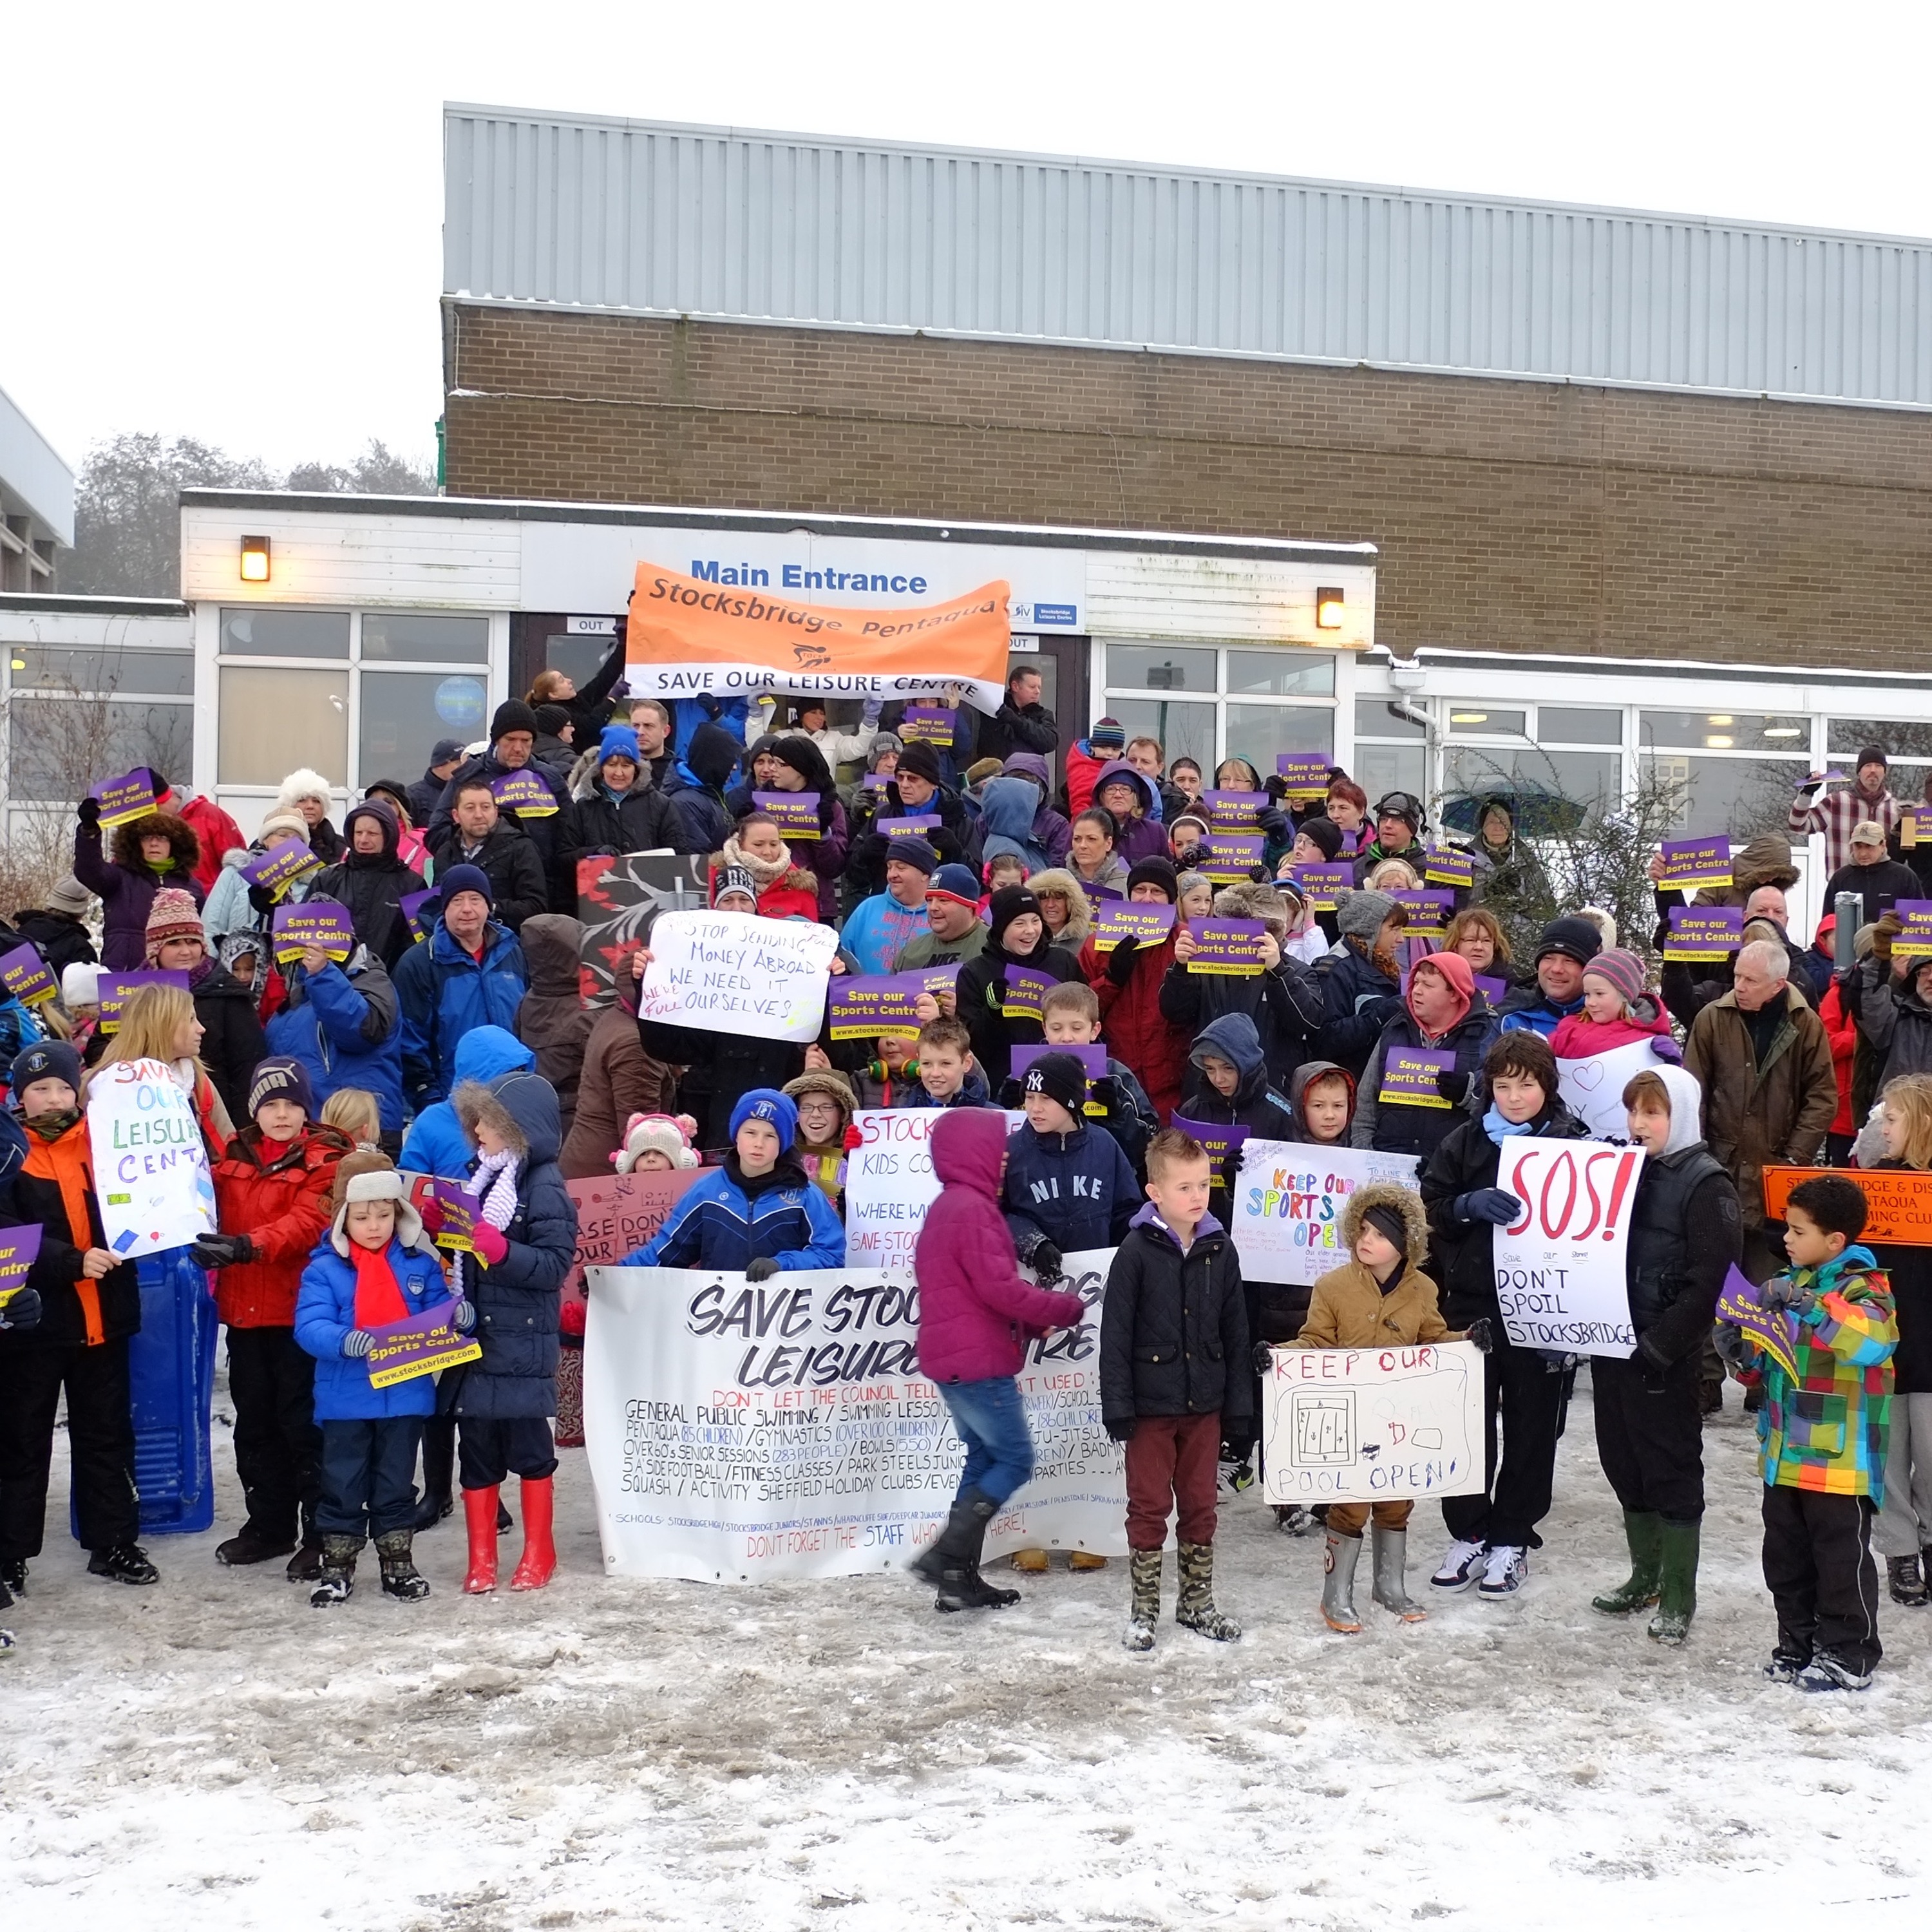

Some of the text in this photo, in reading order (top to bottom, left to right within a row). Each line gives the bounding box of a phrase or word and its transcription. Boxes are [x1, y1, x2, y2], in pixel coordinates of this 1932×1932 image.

[692, 560, 927, 594] Main Entrance
[649, 578, 996, 637] Stocksbridge Pentaqua
[579, 620, 603, 630] OUT
[658, 672, 714, 690] SAVE
[726, 672, 775, 687] OUR
[789, 676, 881, 691] LEISURE
[102, 782, 140, 800] Save our
[504, 781, 526, 791] Save
[124, 790, 153, 803] Centre
[1216, 800, 1237, 809] Save
[766, 803, 787, 811] Save
[788, 815, 818, 823] Centre
[890, 828, 911, 836] Save
[1212, 846, 1233, 855] Save
[1672, 852, 1695, 860] Save
[258, 851, 295, 882] Save our
[284, 853, 314, 875] Centre
[1426, 855, 1470, 869] Sports Centre
[1666, 859, 1728, 874] ports Centre
[287, 918, 337, 927] Save our
[1115, 913, 1139, 922] Save
[1680, 919, 1706, 928] Save
[274, 931, 350, 941] Sports Centre
[684, 923, 730, 939] STOP
[739, 925, 805, 953] SENDING
[1099, 923, 1169, 935] Sports Centre
[1203, 931, 1248, 942] Save our
[1667, 932, 1741, 942] Sports Centre
[691, 942, 816, 974] MONEY ABROAD
[1197, 945, 1224, 955] ports
[5, 965, 24, 981] our
[670, 967, 789, 993] WE NEED IT
[925, 981, 955, 990] Centre
[1019, 980, 1045, 991] Save
[685, 990, 792, 1019] OURSELVES
[848, 991, 904, 1001] Save our
[645, 1002, 682, 1018] FULL
[831, 1006, 875, 1017] Sports
[835, 1027, 916, 1036] www.stocksbridge.com
[115, 1060, 175, 1084] SAVE
[1399, 1060, 1441, 1072] Save our
[1385, 1072, 1414, 1083] Sports
[113, 1118, 202, 1149] LEISUR
[1206, 1141, 1227, 1151] our
[862, 1153, 898, 1175] KIDS
[1030, 1175, 1103, 1204] NIKE
[1273, 1168, 1355, 1194] KEEP OUR
[1246, 1188, 1334, 1222] SPORTS
[1506, 1150, 1637, 1242] SOS!
[856, 1202, 904, 1219] WHERE
[851, 1232, 882, 1251] SAVE
[1502, 1253, 1522, 1264] Save
[1497, 1269, 1569, 1289] DON'T
[687, 1284, 813, 1338] SAVE
[1500, 1293, 1569, 1317] SPOIL
[1719, 1298, 1767, 1325] Sports
[388, 1331, 425, 1343] Save
[1506, 1320, 1637, 1345] STOCKSBRIDGE
[370, 1340, 420, 1361] Sports
[376, 1350, 475, 1383] www.stocksbridge.com
[1274, 1348, 1432, 1381] KEEP OUR
[712, 1372, 1086, 1408] DON'T LET THE COUNCIL TELL USED
[625, 1399, 688, 1424] GENERAL
[697, 1406, 746, 1426] PUBLIC
[753, 1409, 819, 1427] SWIMMING
[840, 1402, 891, 1421] SWIMMING
[627, 1419, 938, 1446] PENTAQUA CHILDREN) GYMNASTICS CHILDREN)
[623, 1426, 1101, 1464] OVER SENIOR SESSIONS (283 PEOPLE) BOWLS JU-JITSU
[622, 1454, 931, 1482] 5 FOOTBALL FITNESS CLASSES PARK STEELS
[621, 1462, 1087, 1502] SQUASH ACTIVITY SHEFFIELD HOLIDAY CLUBS PARTIES
[1278, 1468, 1350, 1493] POOL
[747, 1511, 1027, 1558] DON'T FORGET THE STAFF WHO HERE!
